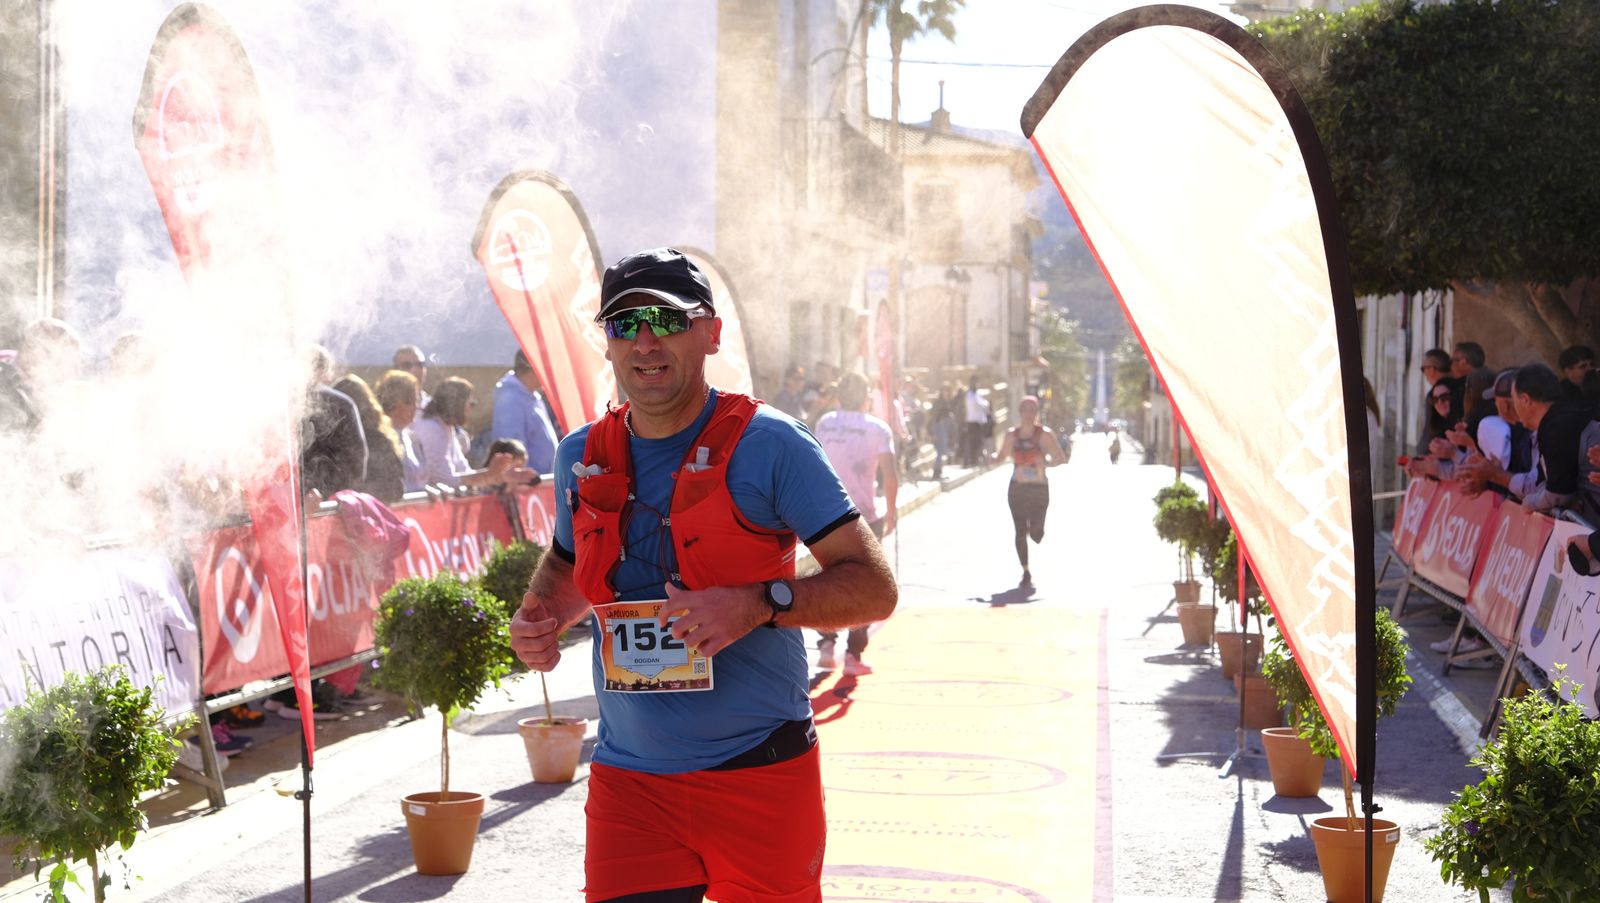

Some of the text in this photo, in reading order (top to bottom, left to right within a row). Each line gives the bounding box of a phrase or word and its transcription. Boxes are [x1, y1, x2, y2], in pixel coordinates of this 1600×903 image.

[1442, 515, 1480, 569] VEOLIA
[307, 559, 371, 621] OLIA
[1497, 542, 1535, 608] VEOLIA
[614, 621, 685, 652] 152
